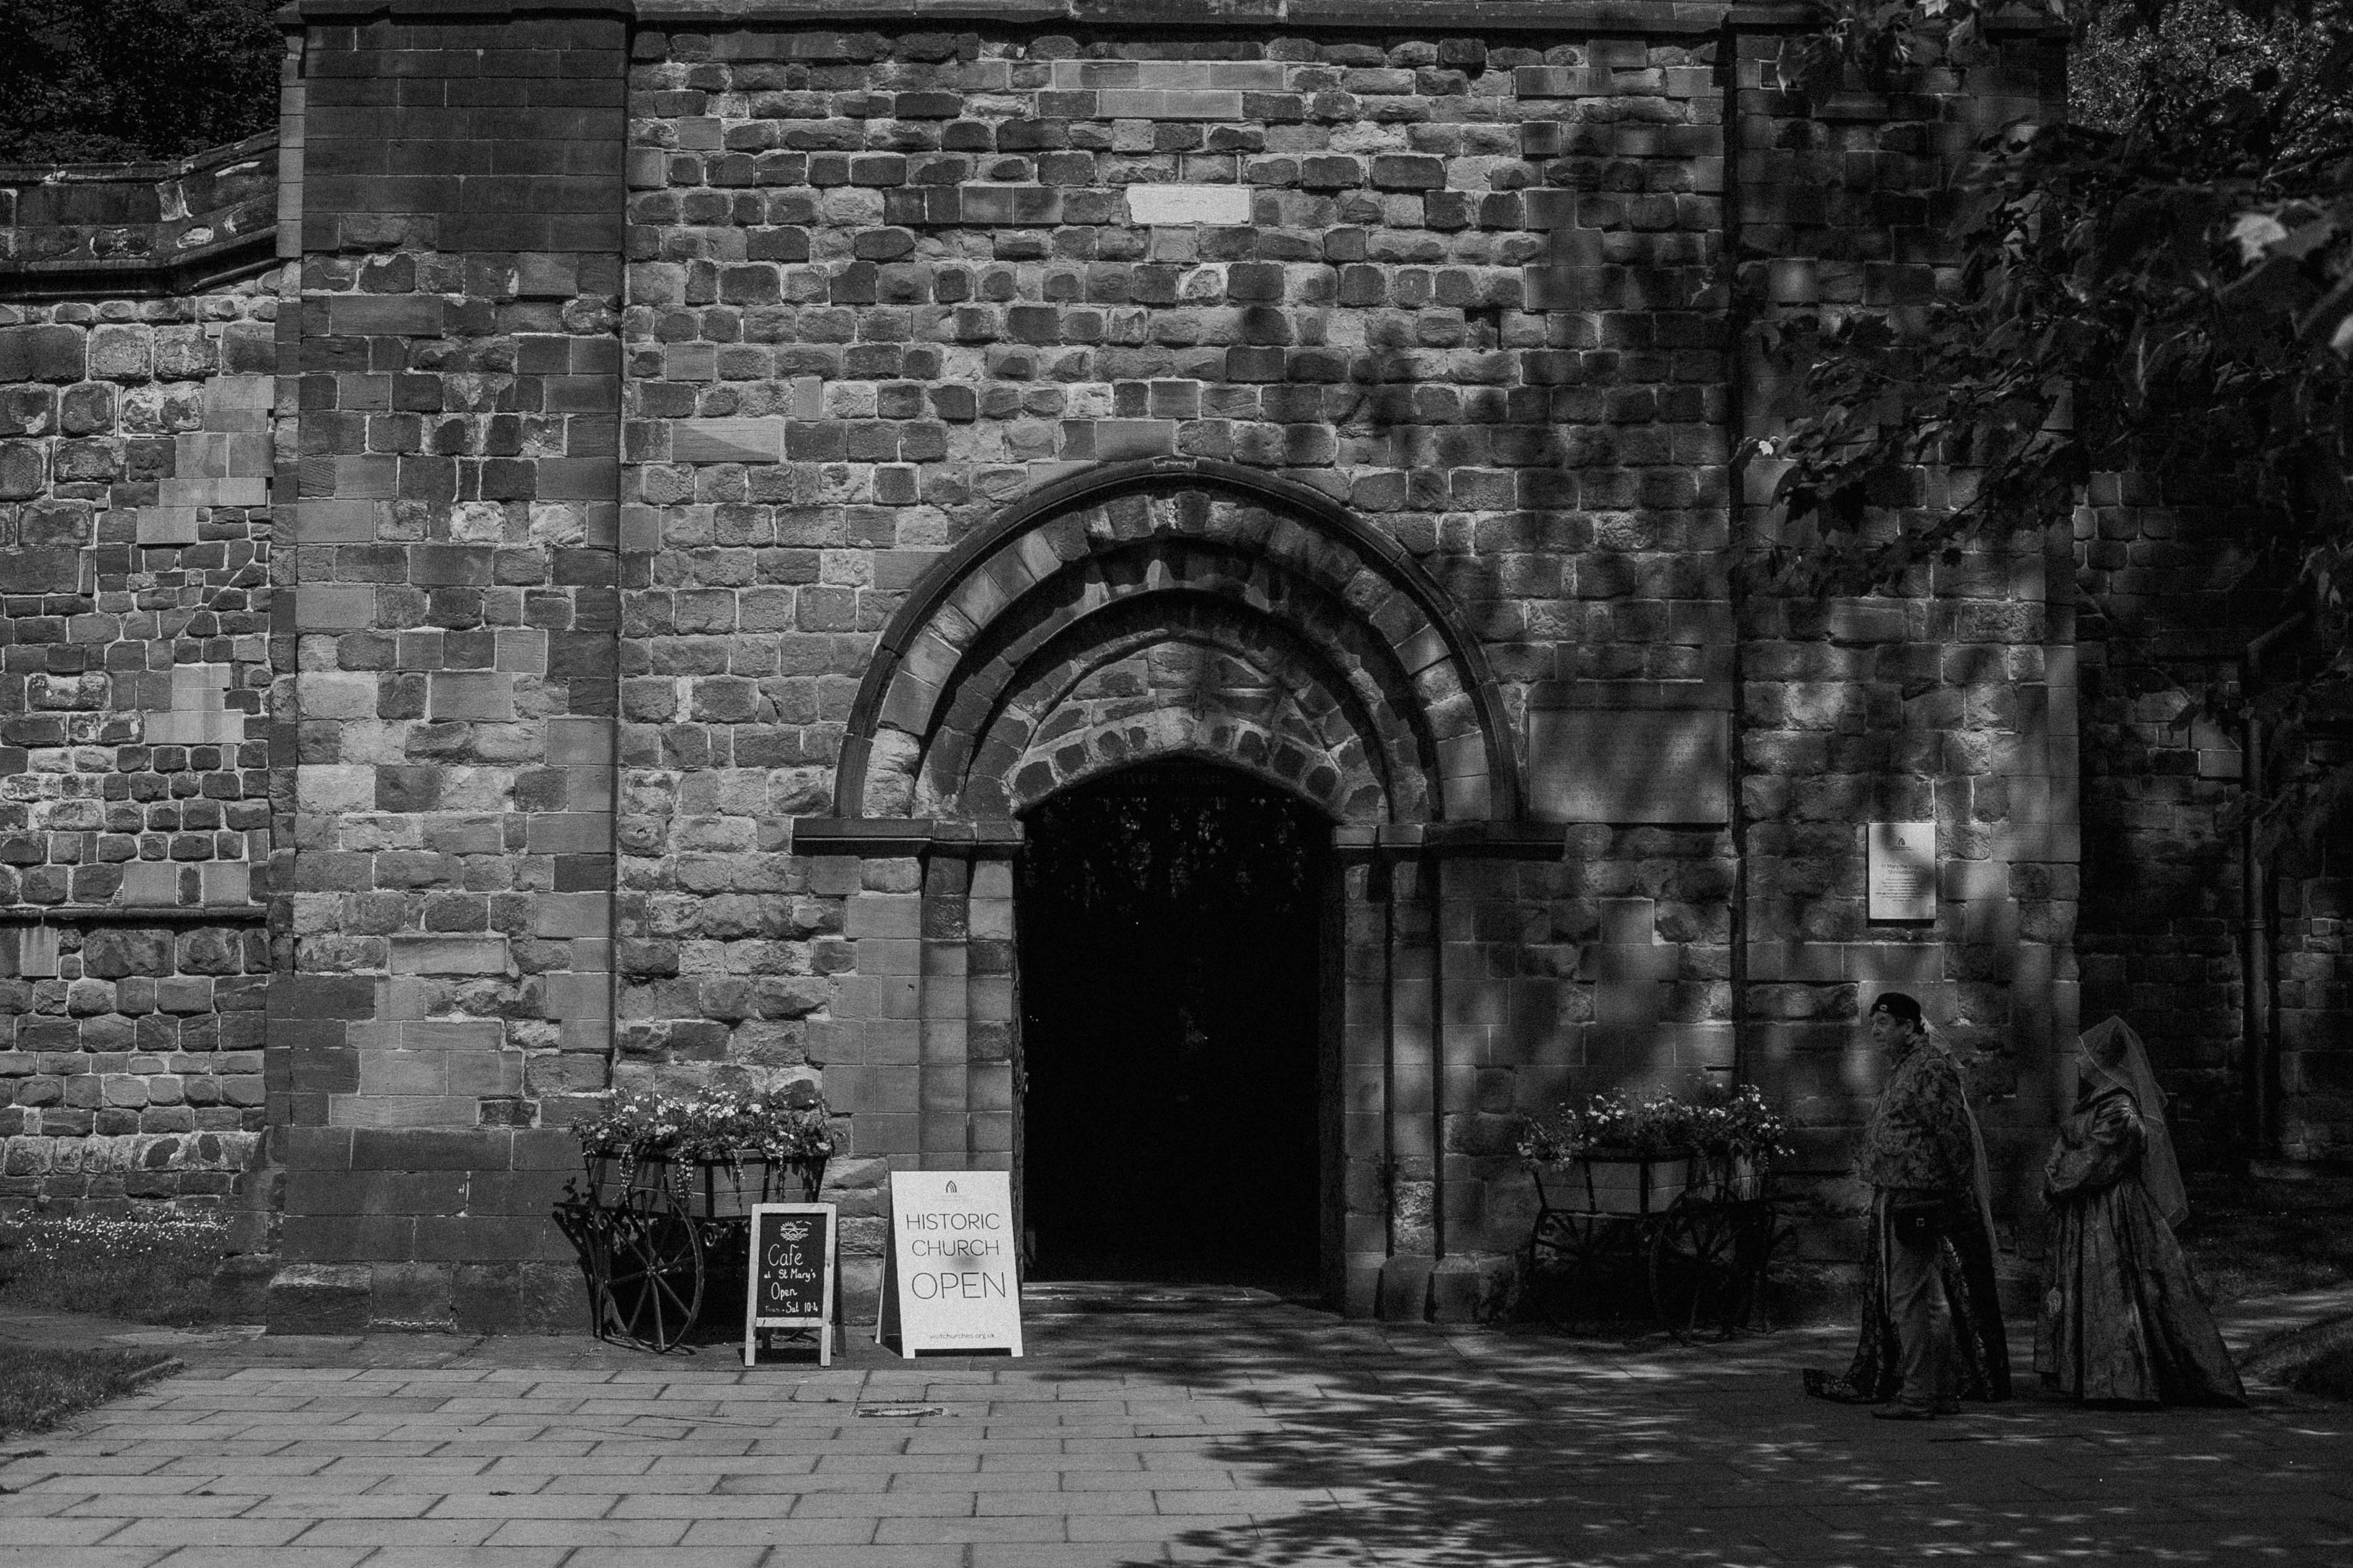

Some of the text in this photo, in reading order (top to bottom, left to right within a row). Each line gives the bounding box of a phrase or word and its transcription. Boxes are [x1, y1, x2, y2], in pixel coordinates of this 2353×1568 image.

[906, 1213, 1000, 1230] HISTORIC
[912, 1239, 999, 1256] CHURCH
[764, 1268, 816, 1282] at St Mary's
[771, 1282, 798, 1300] Open
[912, 1272, 1006, 1300] OPEN
[786, 1301, 799, 1313] Sat
